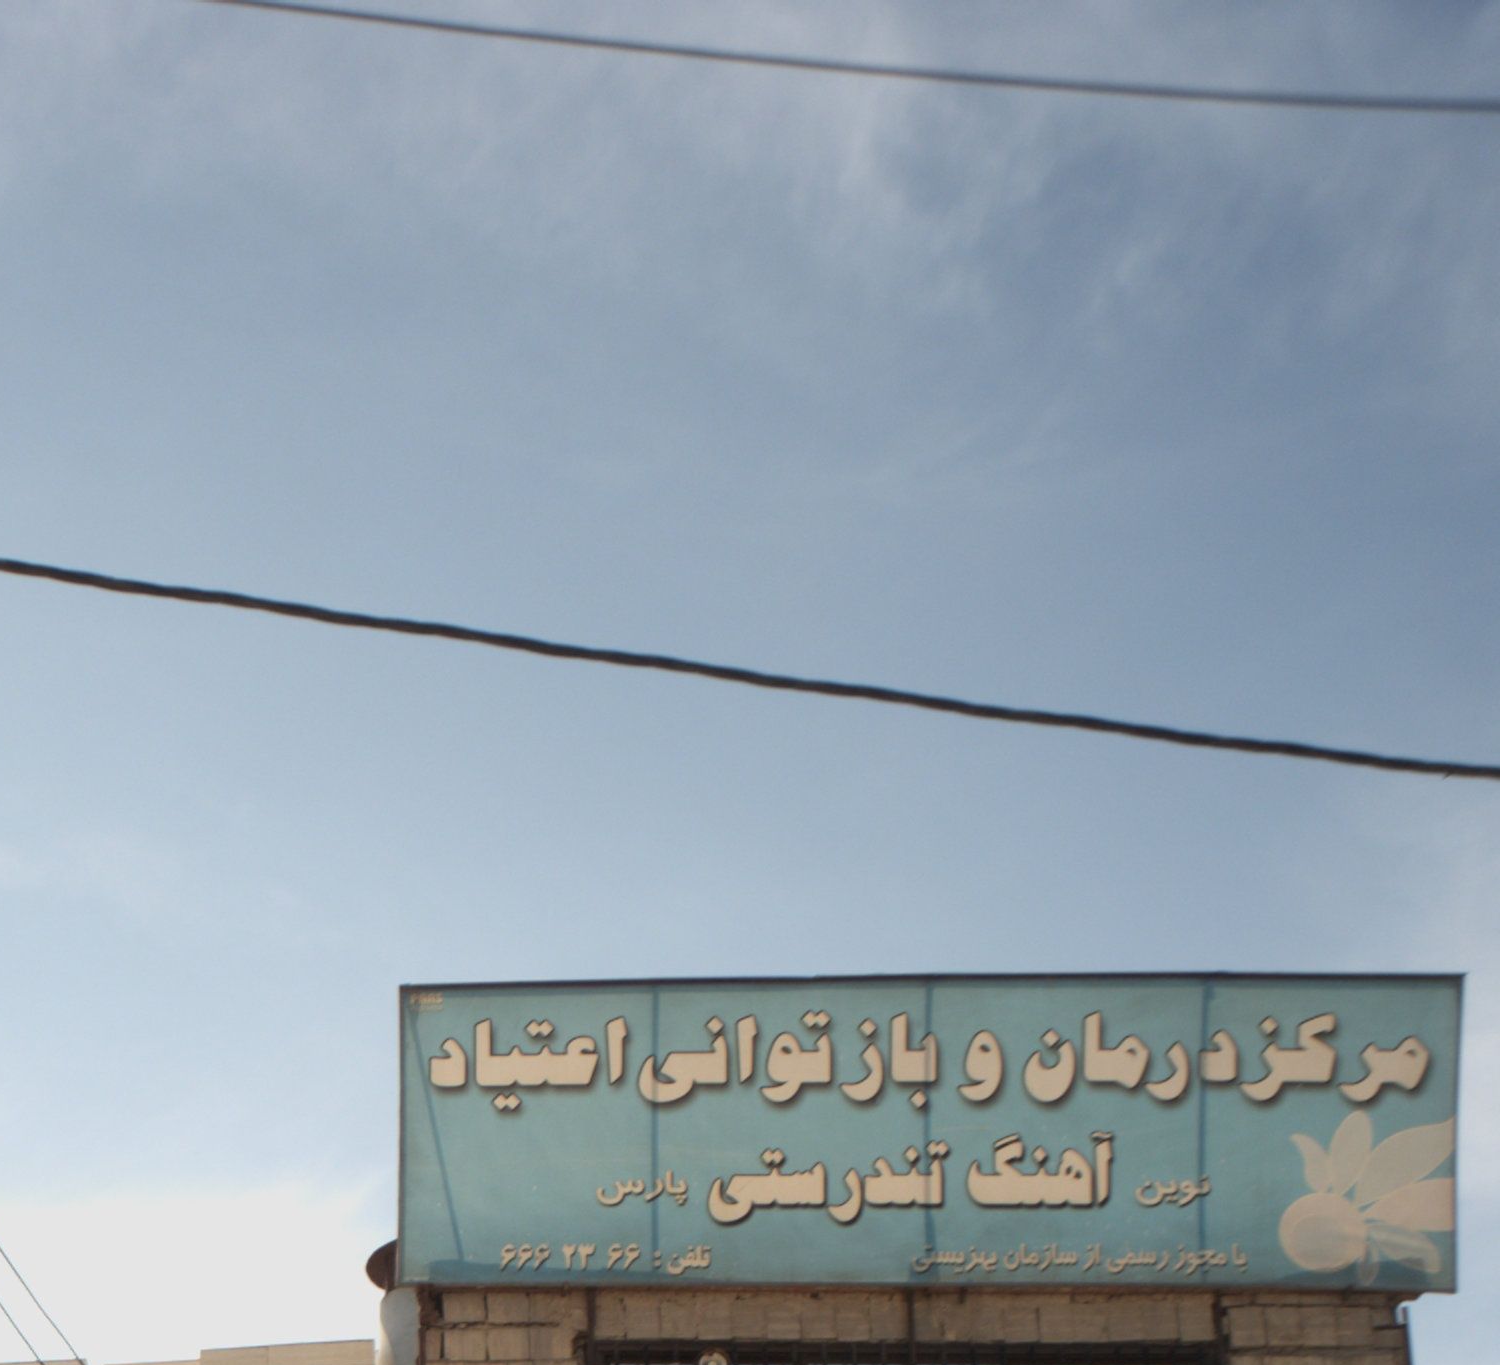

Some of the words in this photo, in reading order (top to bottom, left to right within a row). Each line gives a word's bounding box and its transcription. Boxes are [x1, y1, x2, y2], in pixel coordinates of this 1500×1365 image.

[430, 1016, 627, 1111] اعتیاد
[958, 1030, 1003, 1101] و
[1023, 1010, 1237, 1102] درمان
[1239, 1011, 1430, 1102] مرکز
[597, 1170, 688, 1205] پارس
[707, 1139, 949, 1223] تندرستی
[967, 1133, 1114, 1209] آهنگ
[1135, 1174, 1211, 1205] نوین
[912, 1243, 997, 1273] بهزیستی
[1004, 1244, 1078, 1270] سازمان
[1083, 1243, 1100, 1271] از
[1107, 1247, 1169, 1274] رسمی
[1176, 1247, 1227, 1274] مجوز
[1232, 1244, 1248, 1273] با
